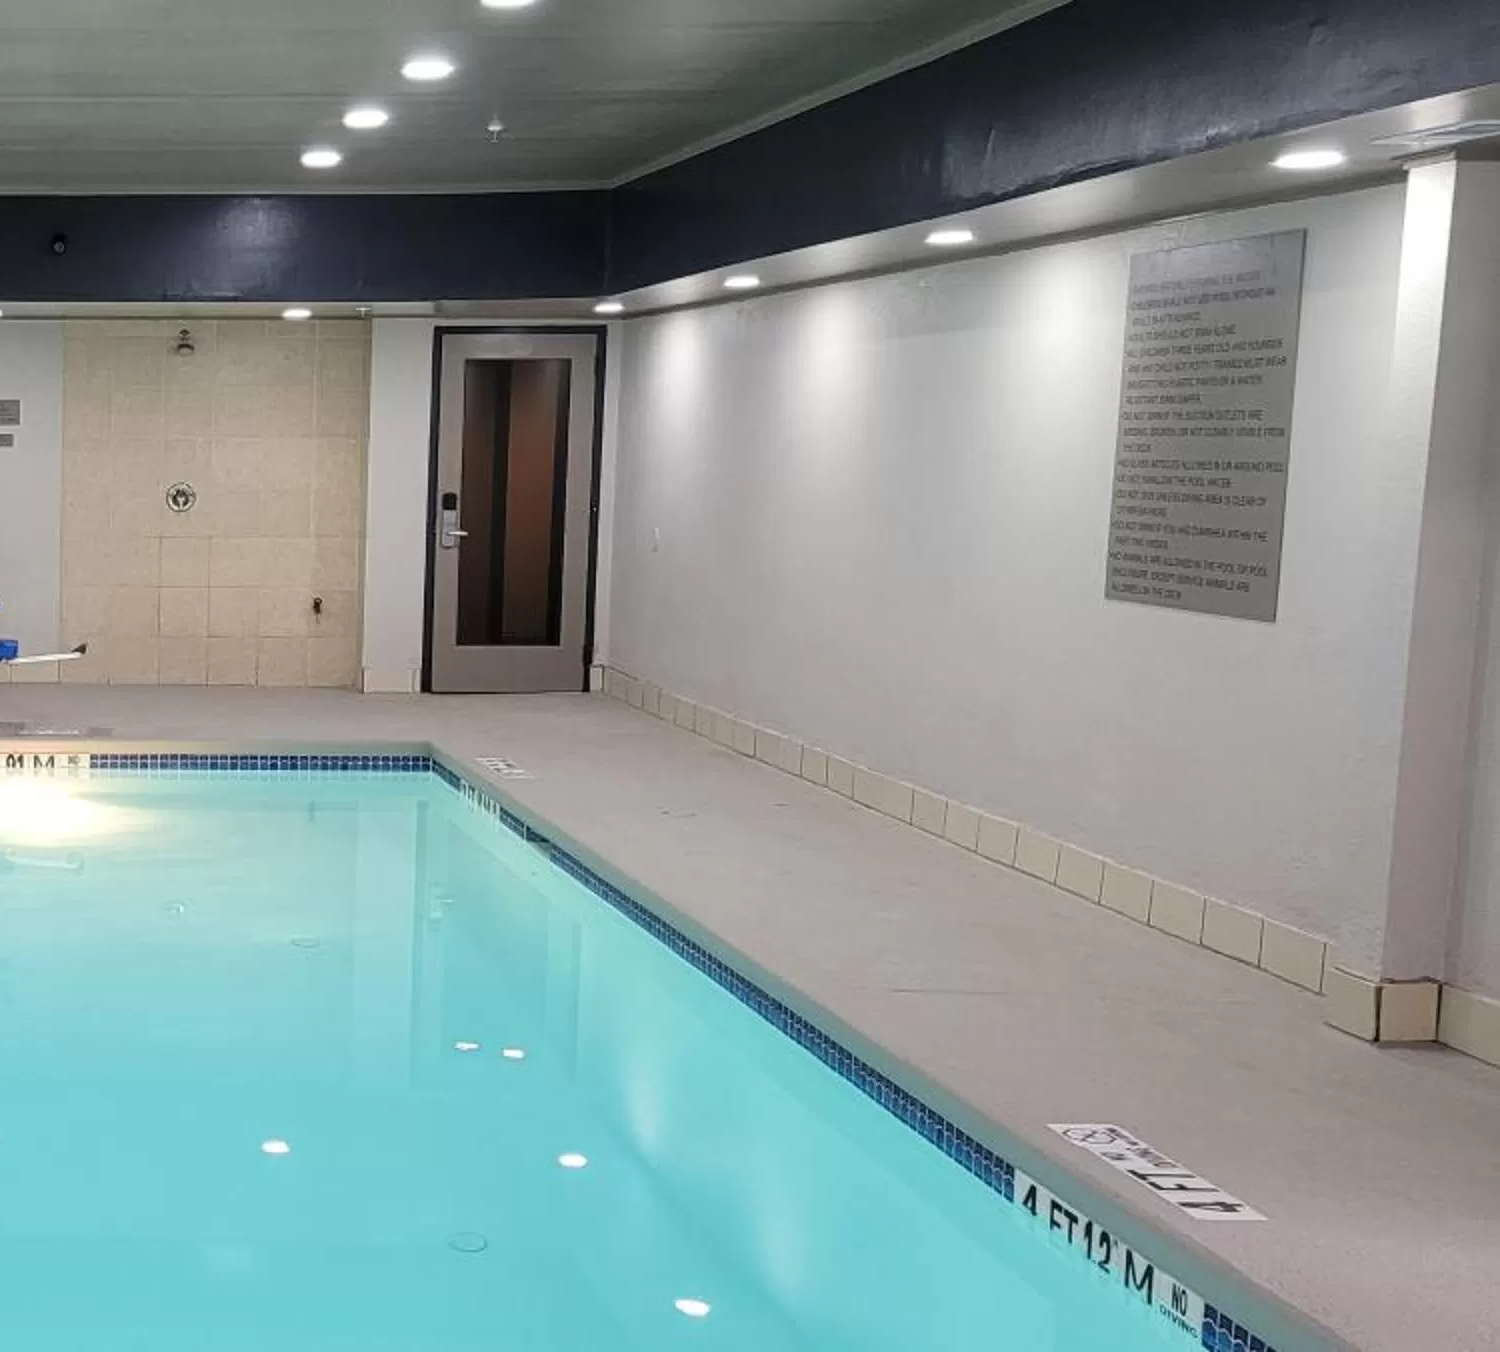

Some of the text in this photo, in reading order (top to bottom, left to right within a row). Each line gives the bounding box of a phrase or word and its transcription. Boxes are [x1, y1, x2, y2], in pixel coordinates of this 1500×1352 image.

[33, 755, 55, 769] M
[1125, 1168, 1221, 1193] FT
[1177, 1201, 1245, 1213] 4
[1023, 1184, 1037, 1216] 4
[1049, 1199, 1079, 1245] FT
[1124, 1248, 1154, 1306] M
[1171, 1283, 1187, 1316] NO
